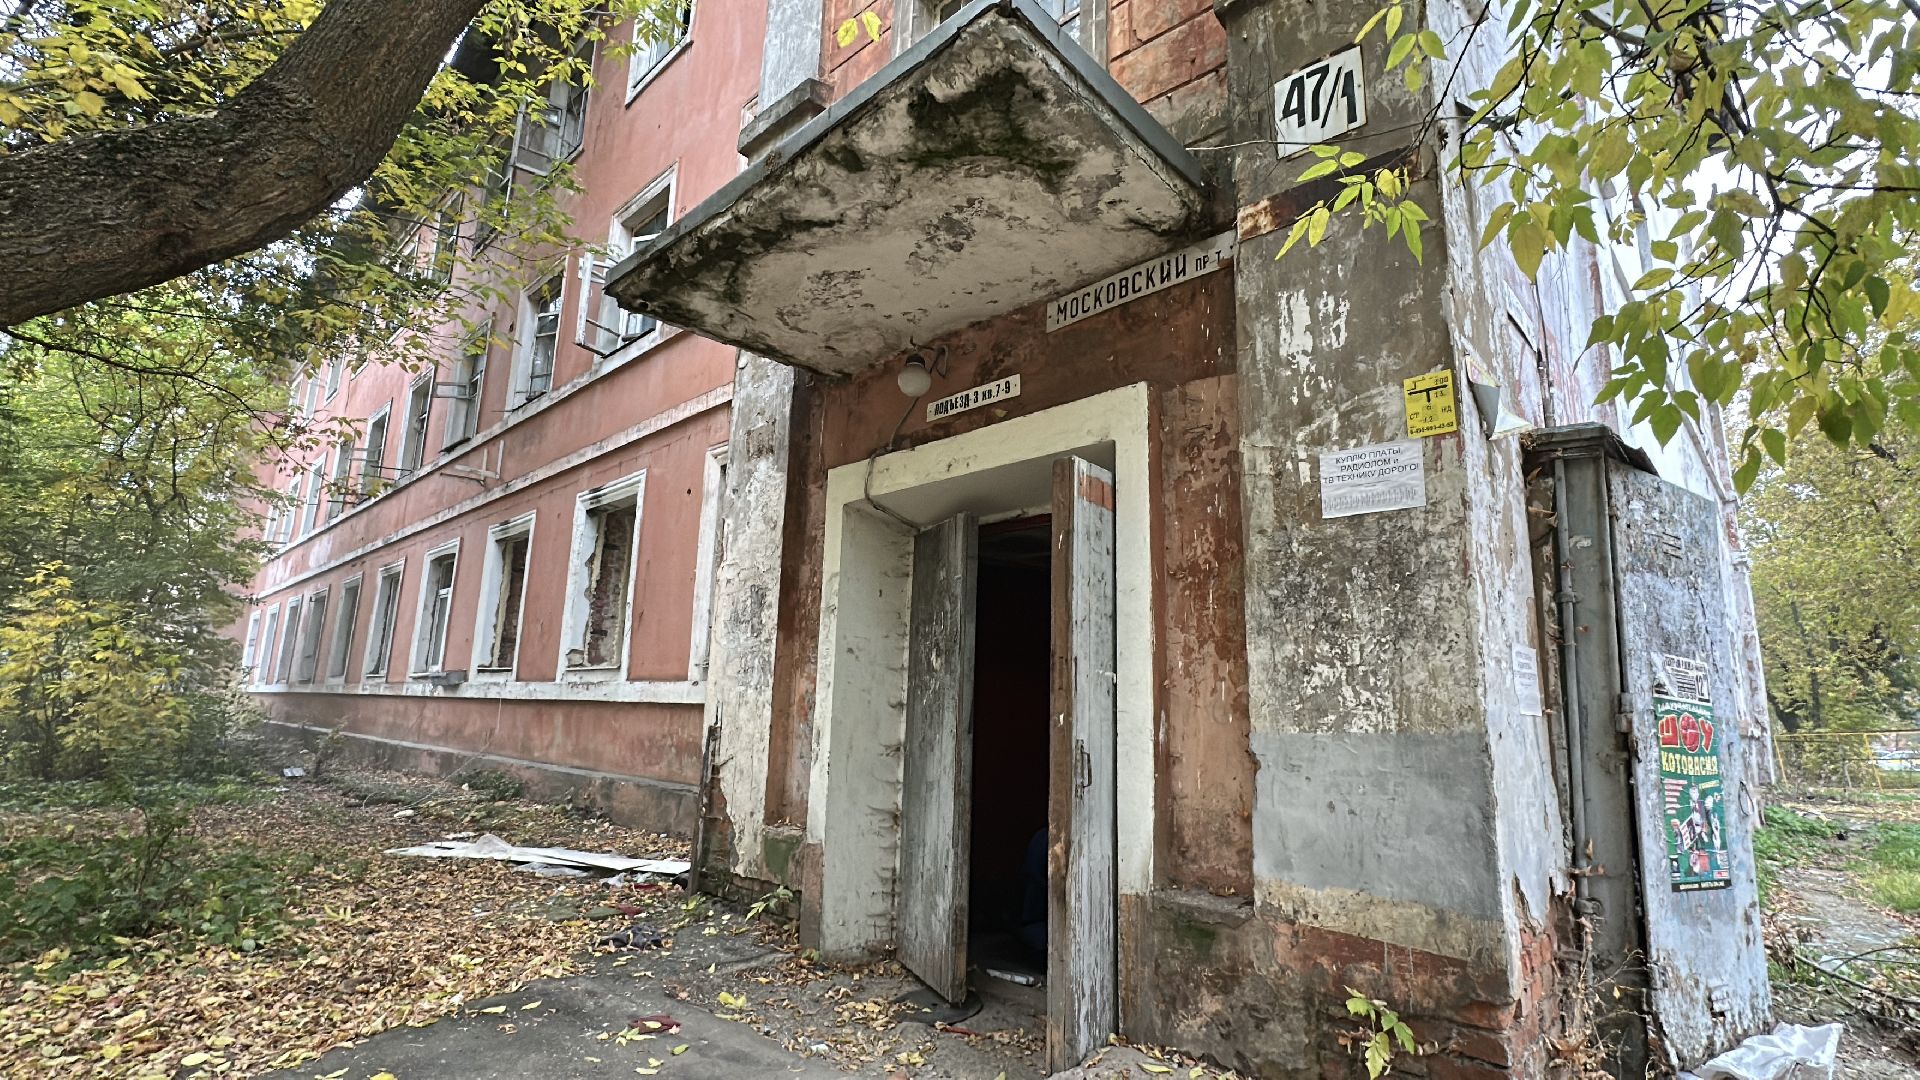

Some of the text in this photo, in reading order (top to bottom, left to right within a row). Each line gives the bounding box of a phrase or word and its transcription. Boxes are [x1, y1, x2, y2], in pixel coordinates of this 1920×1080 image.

[1280, 64, 1358, 128] 47/1
[1056, 253, 1187, 325] МОСКОВСКИЙ
[1335, 452, 1367, 465] КУПЛЮ
[1340, 458, 1391, 473] РАДИОЛОМ
[1323, 476, 1335, 484] ТВ
[1336, 470, 1376, 483] ТЕХНИКУ
[1658, 712, 1715, 754] ШОУ
[1661, 751, 1719, 776] КОТОВАСИЯ
